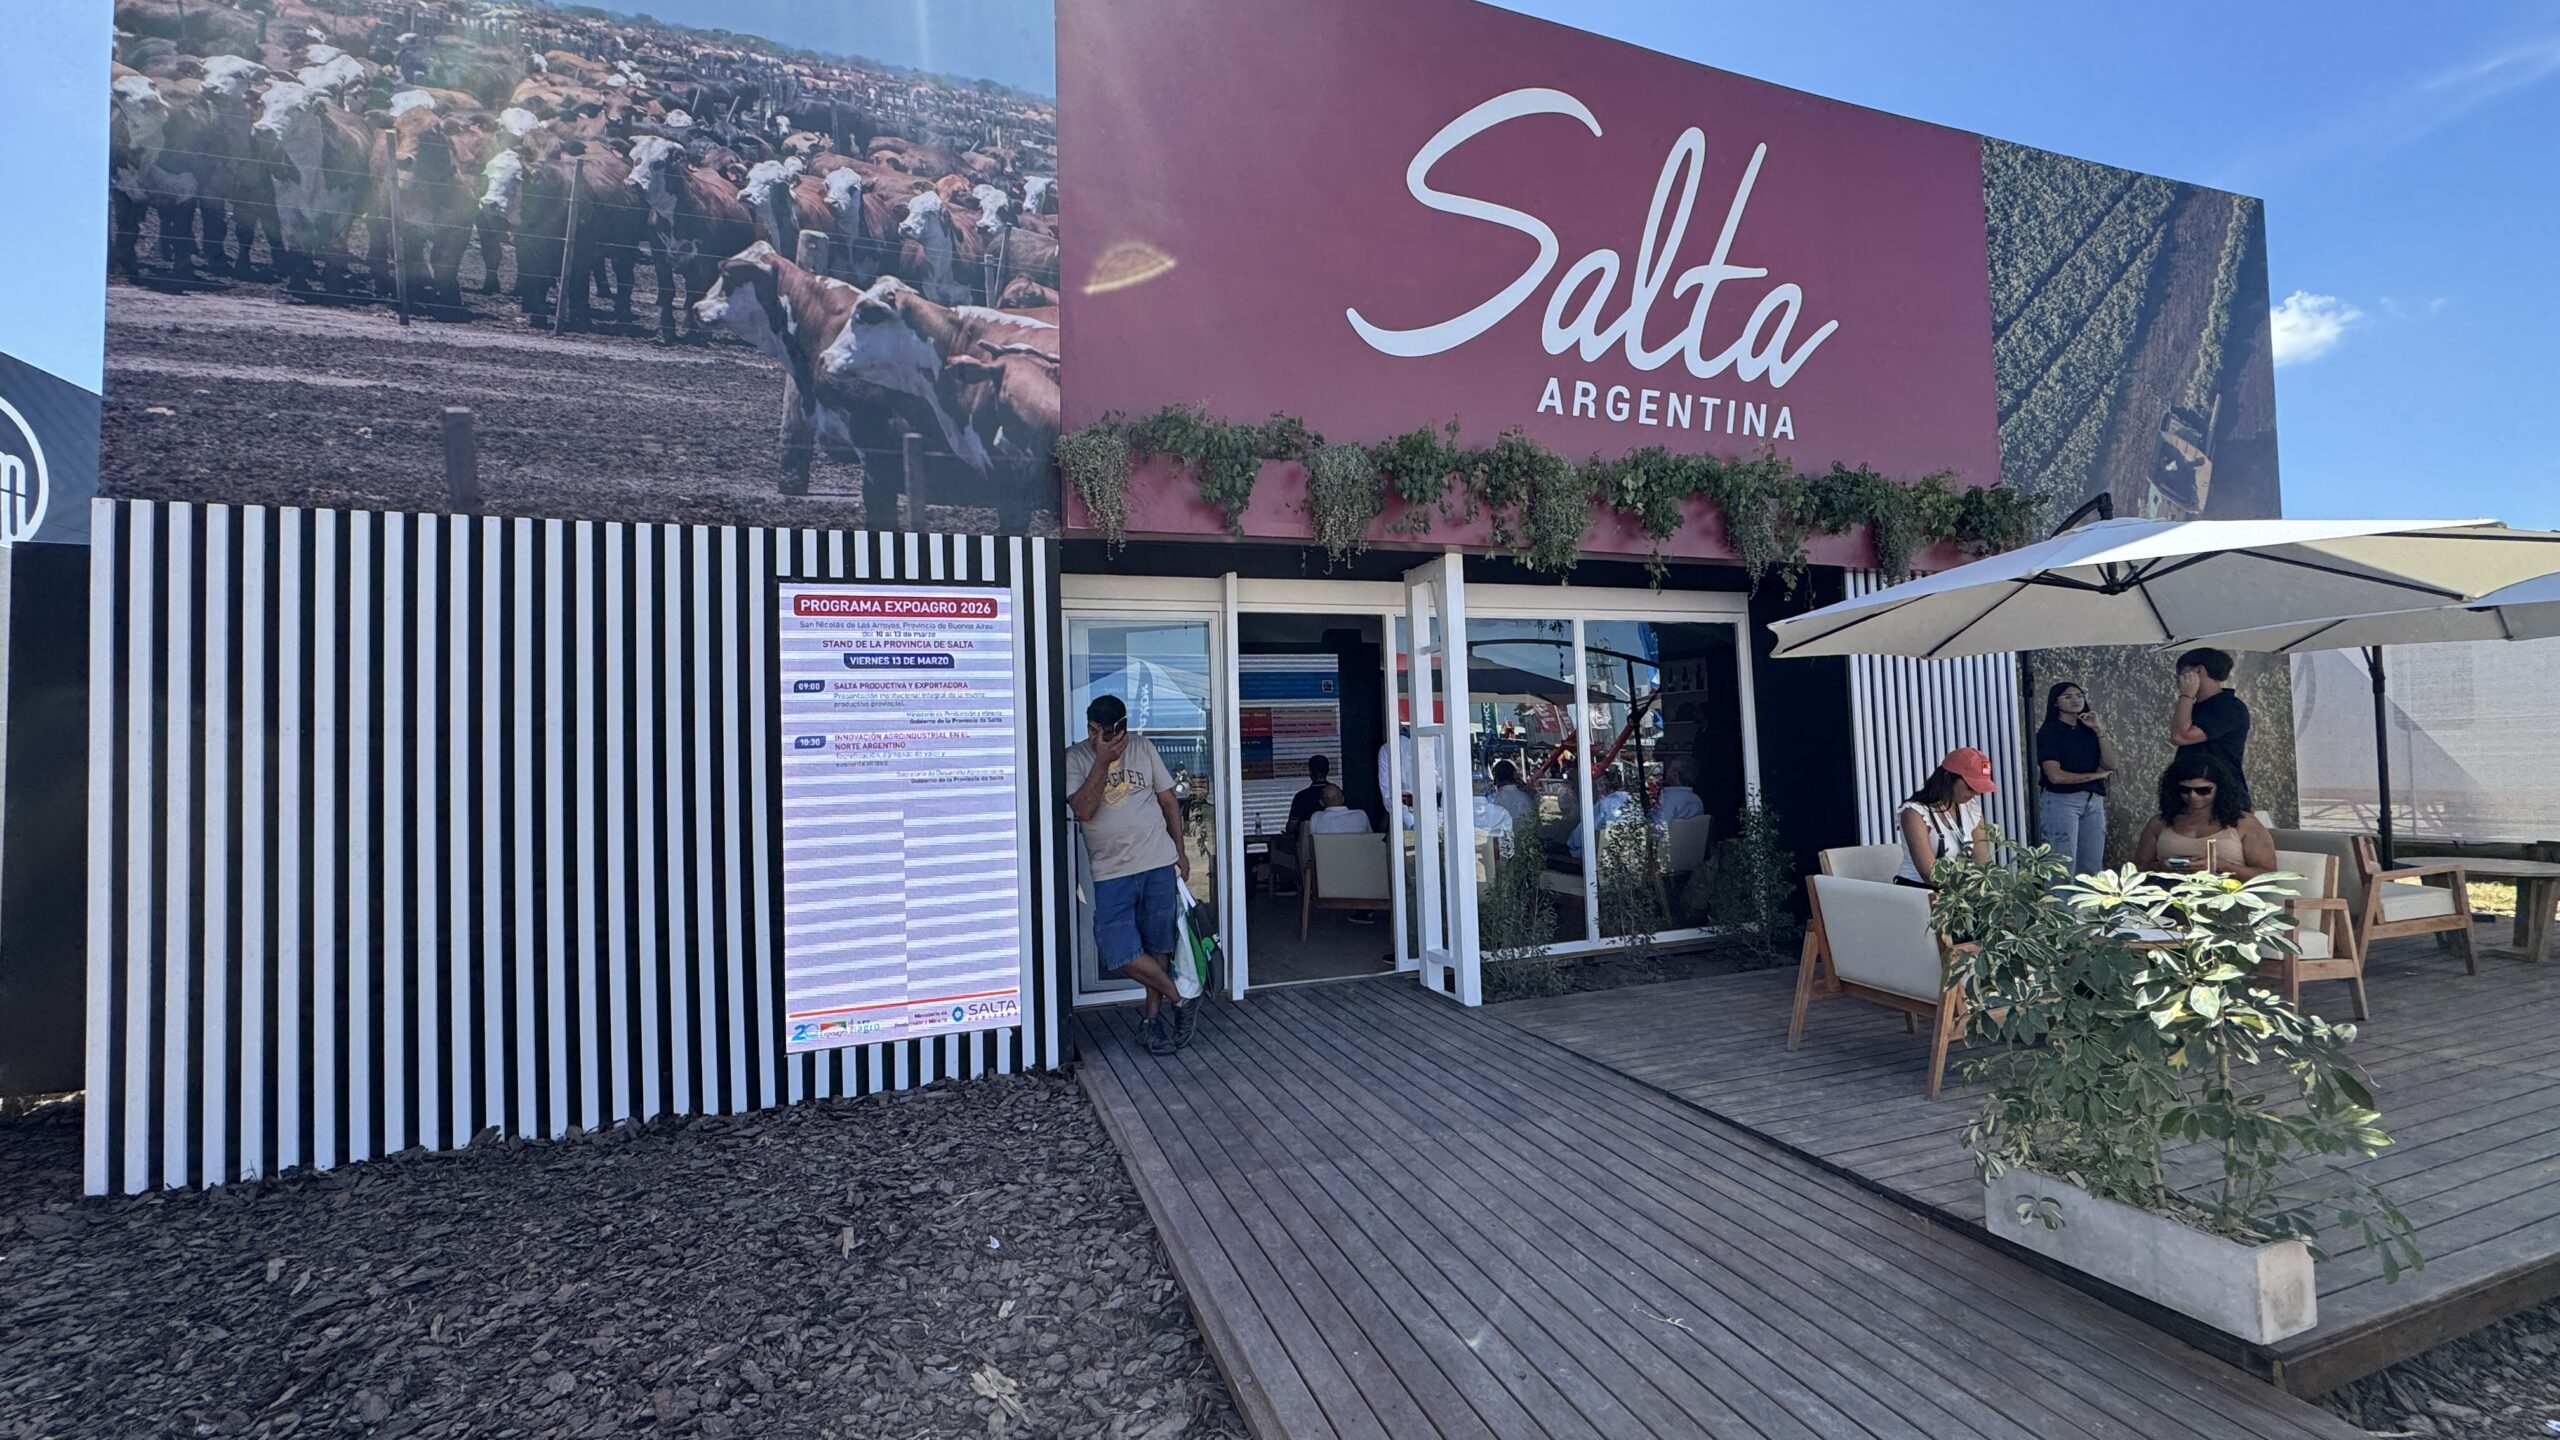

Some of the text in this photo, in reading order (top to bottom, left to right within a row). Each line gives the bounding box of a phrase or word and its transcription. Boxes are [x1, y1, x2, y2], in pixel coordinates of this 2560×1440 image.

[1346, 87, 1839, 389] Salta
[1537, 377, 1795, 440] ARGENTINA
[800, 599, 991, 614] PROGRAMA EXPOAGRO 2026
[799, 620, 814, 629] San
[846, 621, 856, 629] de
[902, 622, 936, 630] Provincia
[937, 622, 946, 630] de
[822, 640, 974, 649] STAND DE LA PROVINCIA DE SALTA
[849, 656, 949, 665] VIERNES 13 DE MARZO
[798, 682, 820, 691] 09:00
[833, 682, 858, 690] SALTA
[859, 682, 908, 690] PRODUCTIVA
[835, 731, 882, 740] INNOVACIÓN
[883, 731, 947, 740] AGROINDUSTRIAL
[800, 737, 821, 746] 10:30
[835, 741, 906, 750] NORTE ARGENTINO
[968, 1000, 1017, 1016] SALTA
